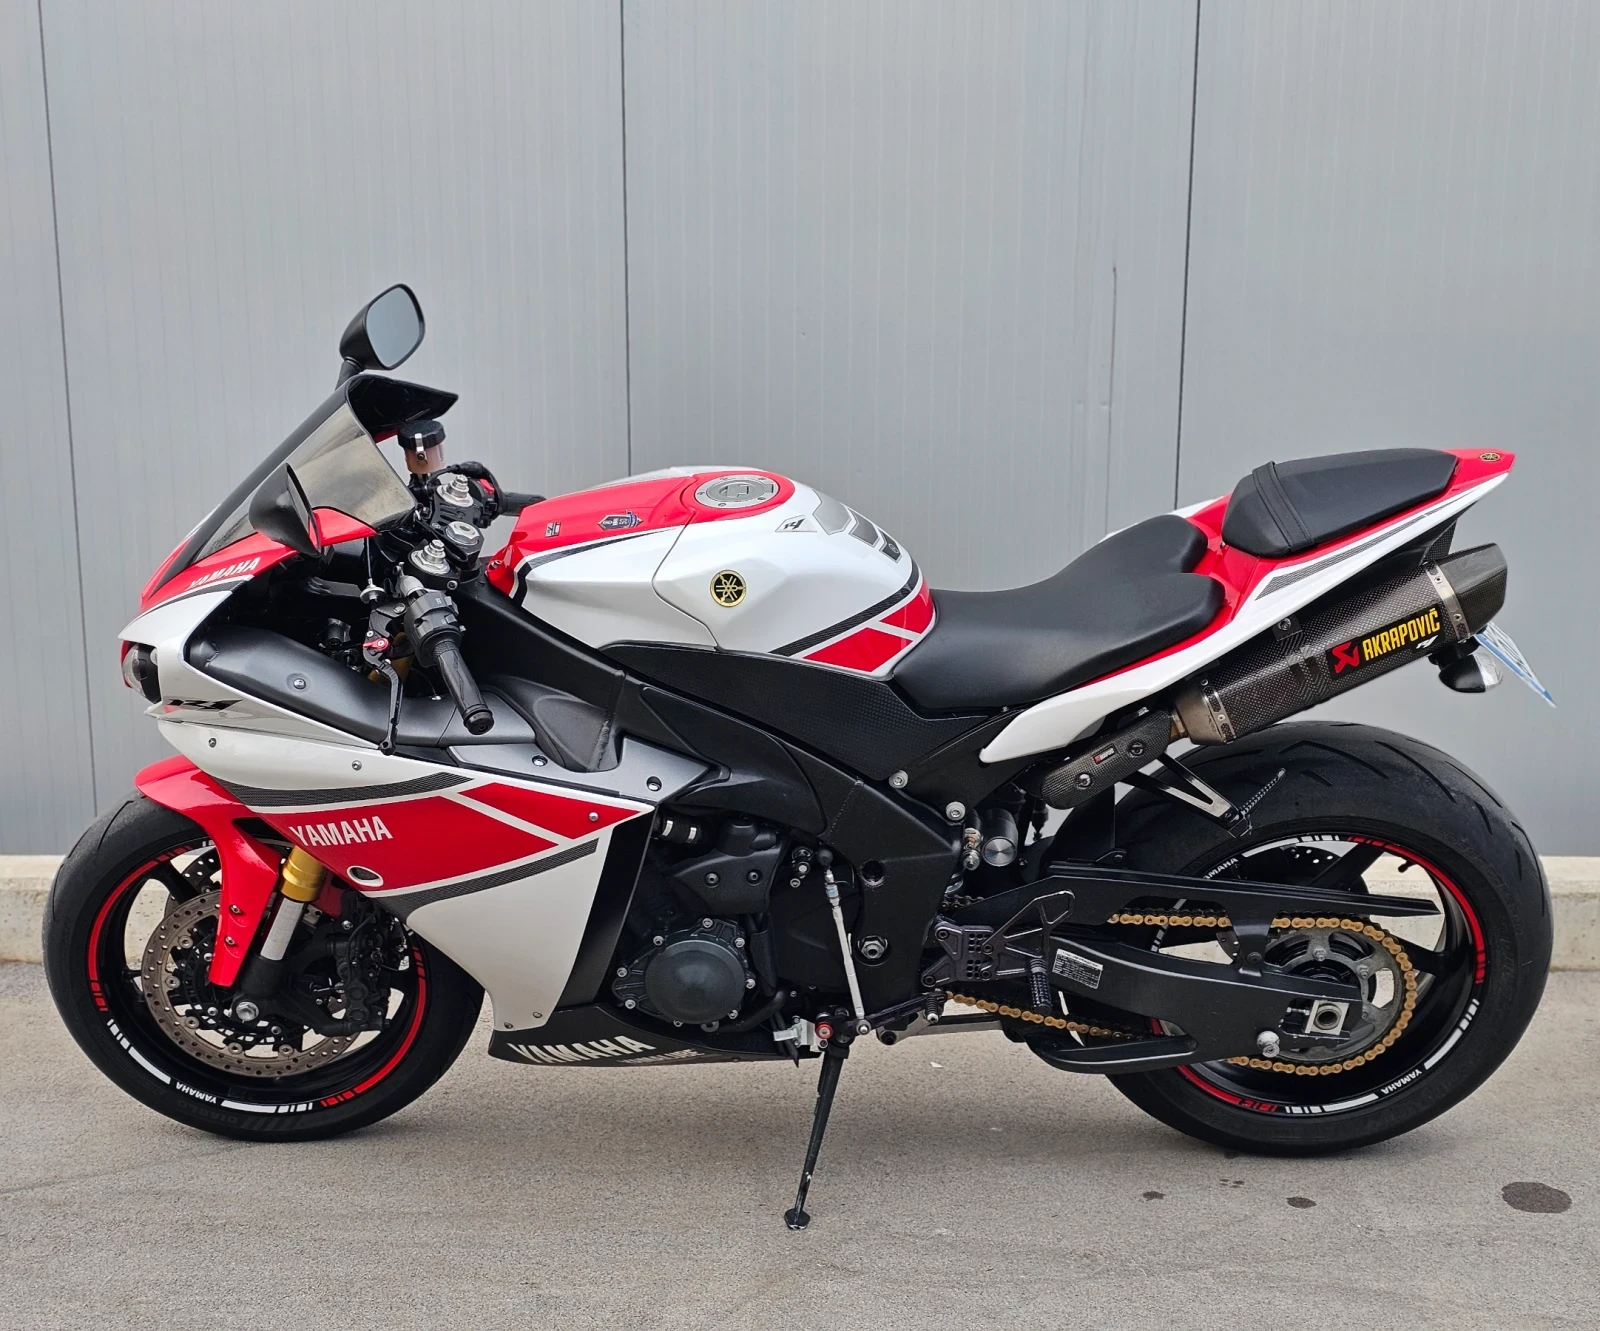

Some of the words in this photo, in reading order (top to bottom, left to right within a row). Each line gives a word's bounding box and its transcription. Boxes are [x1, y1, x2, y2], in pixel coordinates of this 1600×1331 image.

[185, 557, 261, 591] YAMAHA
[289, 815, 393, 846] YAMAHA
[1203, 857, 1238, 879] AMAHA
[507, 1035, 657, 1063] YAMAHA
[175, 1081, 217, 1104] YAMAHA
[1380, 1068, 1423, 1094] YAMAHA
